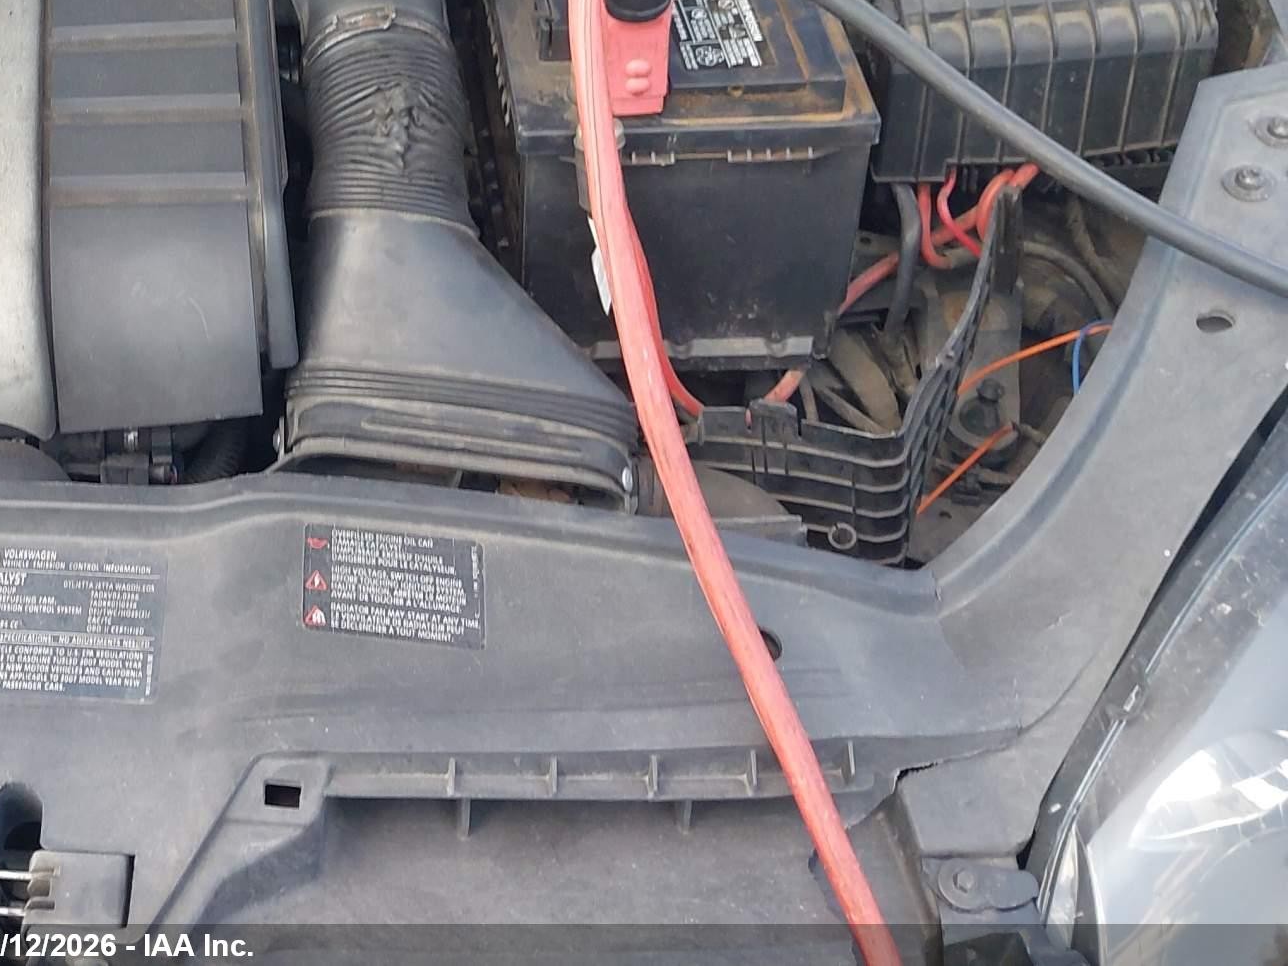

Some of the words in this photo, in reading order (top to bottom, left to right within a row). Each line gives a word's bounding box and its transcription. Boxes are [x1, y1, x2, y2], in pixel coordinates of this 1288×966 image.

[332, 530, 374, 542] OVERFILLED
[376, 534, 403, 545] ENGINE
[404, 537, 417, 546] OIL
[417, 538, 434, 548] CAN
[4, 549, 57, 561] VOLKSWAGEN
[33, 561, 66, 571] EMISSION
[68, 562, 99, 572] CONTROL
[103, 564, 152, 575] INFORMATION
[378, 558, 398, 569] POUR
[399, 560, 408, 570] LE
[332, 565, 351, 576] HIGH
[420, 575, 434, 585] OFF
[435, 576, 463, 588] ENGINE
[332, 574, 358, 585] BEFORE
[331, 582, 356, 593] HAUTE
[436, 593, 467, 605] MOTEUR
[331, 590, 357, 602] AVANT
[359, 593, 368, 603] DE
[370, 595, 404, 607] TOUCHER
[24, 604, 55, 614] CONTROL
[56, 605, 82, 615] SYSTEM
[331, 602, 369, 615] RADIATOR
[371, 607, 386, 617] FAN
[387, 609, 405, 619] MAY
[407, 611, 430, 622] START
[432, 614, 441, 624] AT
[443, 616, 460, 626] ANY
[396, 627, 415, 638] TOUT
[447, 624, 465, 634] PEUT
[14, 645, 54, 656] CONFORMS
[56, 647, 65, 656] TO
[96, 649, 144, 660] REGULATIONS
[7, 654, 16, 663] TO
[17, 654, 51, 665] GASOLINE
[98, 659, 123, 669] MODEL
[124, 661, 143, 670] YEAR
[6, 663, 23, 673] NEW
[24, 663, 50, 674] MOTOR
[51, 665, 83, 676] VEHICLES
[84, 667, 100, 676] AND
[101, 669, 144, 679] CALIFORNIA
[3, 680, 43, 691] PASSENGER
[9, 671, 49, 682] APPLICABLE
[50, 673, 60, 682] TO
[78, 675, 103, 685] MODEL
[104, 677, 123, 687] YEAR
[123, 678, 142, 688] NEW
